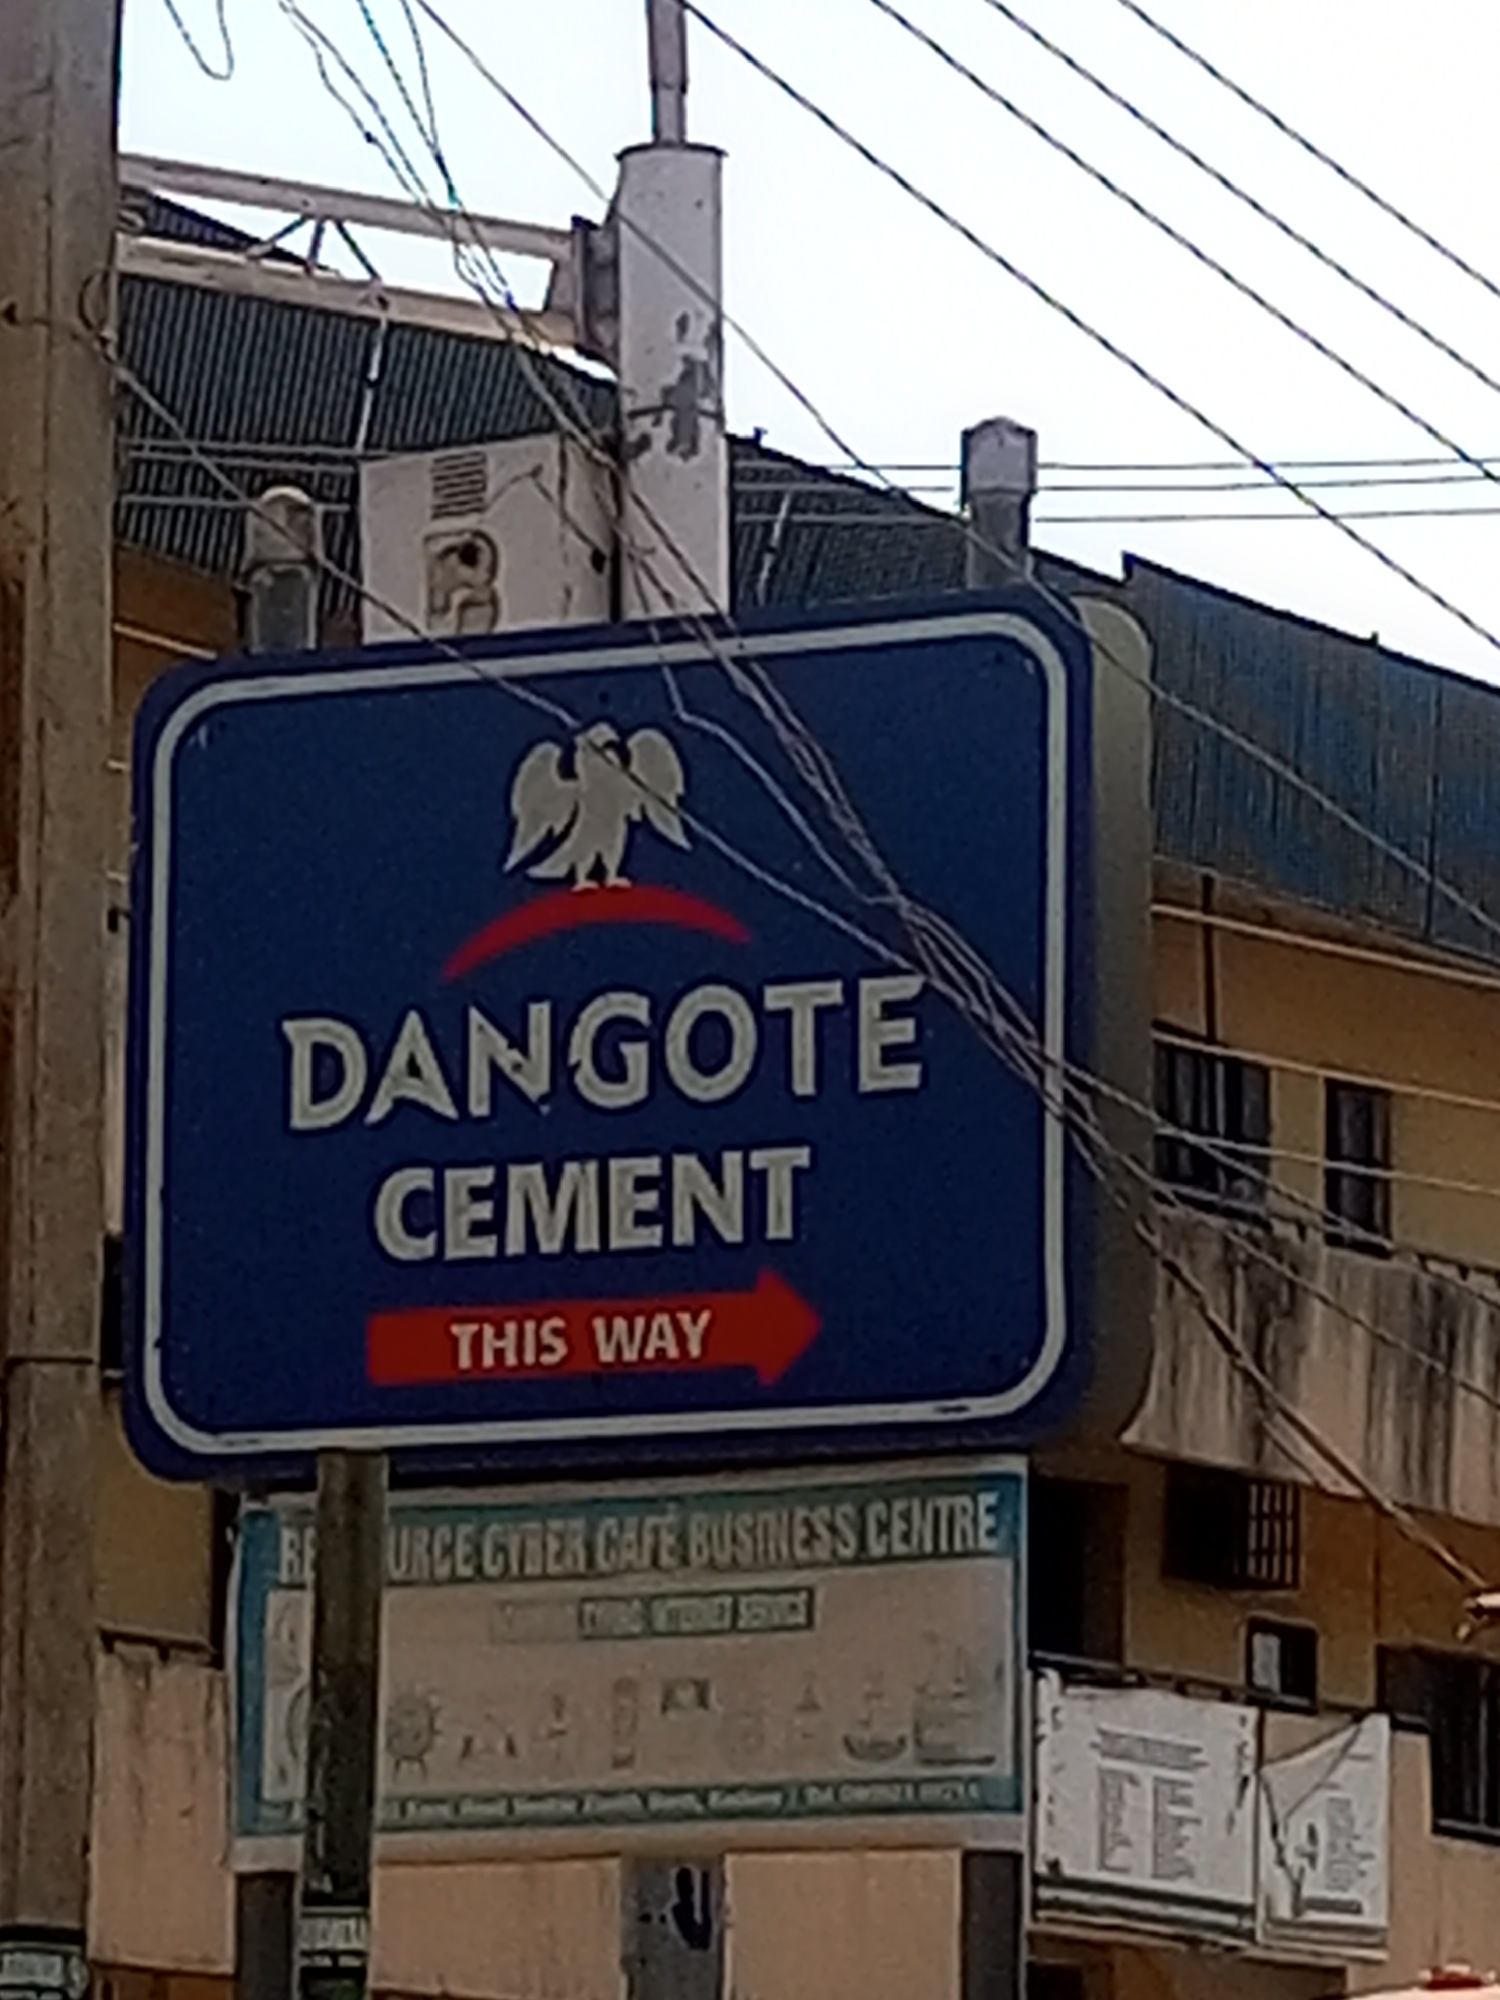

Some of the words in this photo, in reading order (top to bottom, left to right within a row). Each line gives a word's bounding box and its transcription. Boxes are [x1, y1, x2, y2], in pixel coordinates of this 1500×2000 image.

[282, 976, 925, 1130] DANGOTE
[374, 1147, 811, 1261] CEMENT
[450, 1317, 568, 1369] THIS
[592, 1309, 712, 1363] WAY
[688, 1505, 859, 1571] BUSINESS
[866, 1491, 1000, 1558] CENTRE
